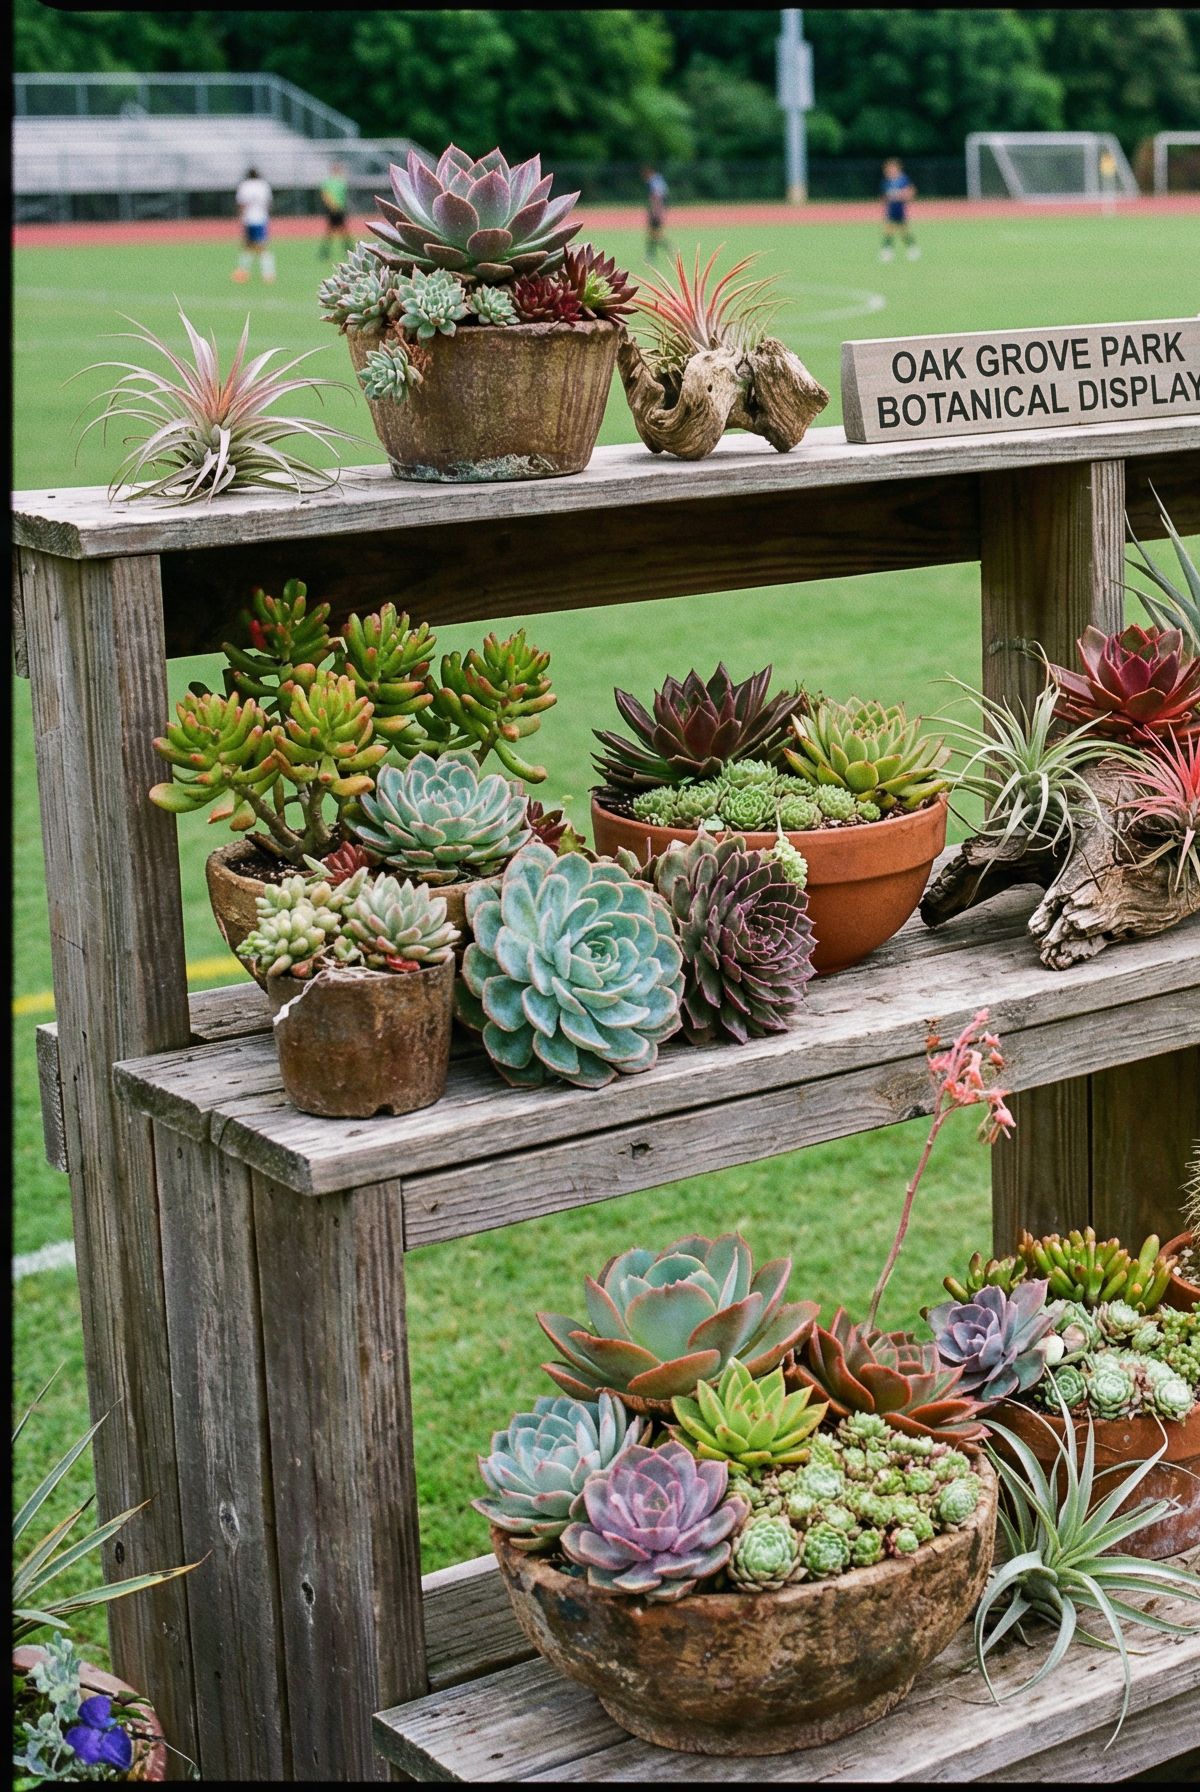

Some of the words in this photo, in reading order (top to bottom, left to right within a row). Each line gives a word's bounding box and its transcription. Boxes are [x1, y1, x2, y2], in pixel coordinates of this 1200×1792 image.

[891, 347, 967, 384] OAK
[975, 338, 1092, 378] GROVE
[1101, 331, 1186, 367] PARK
[877, 382, 1069, 429] BOTANICAL
